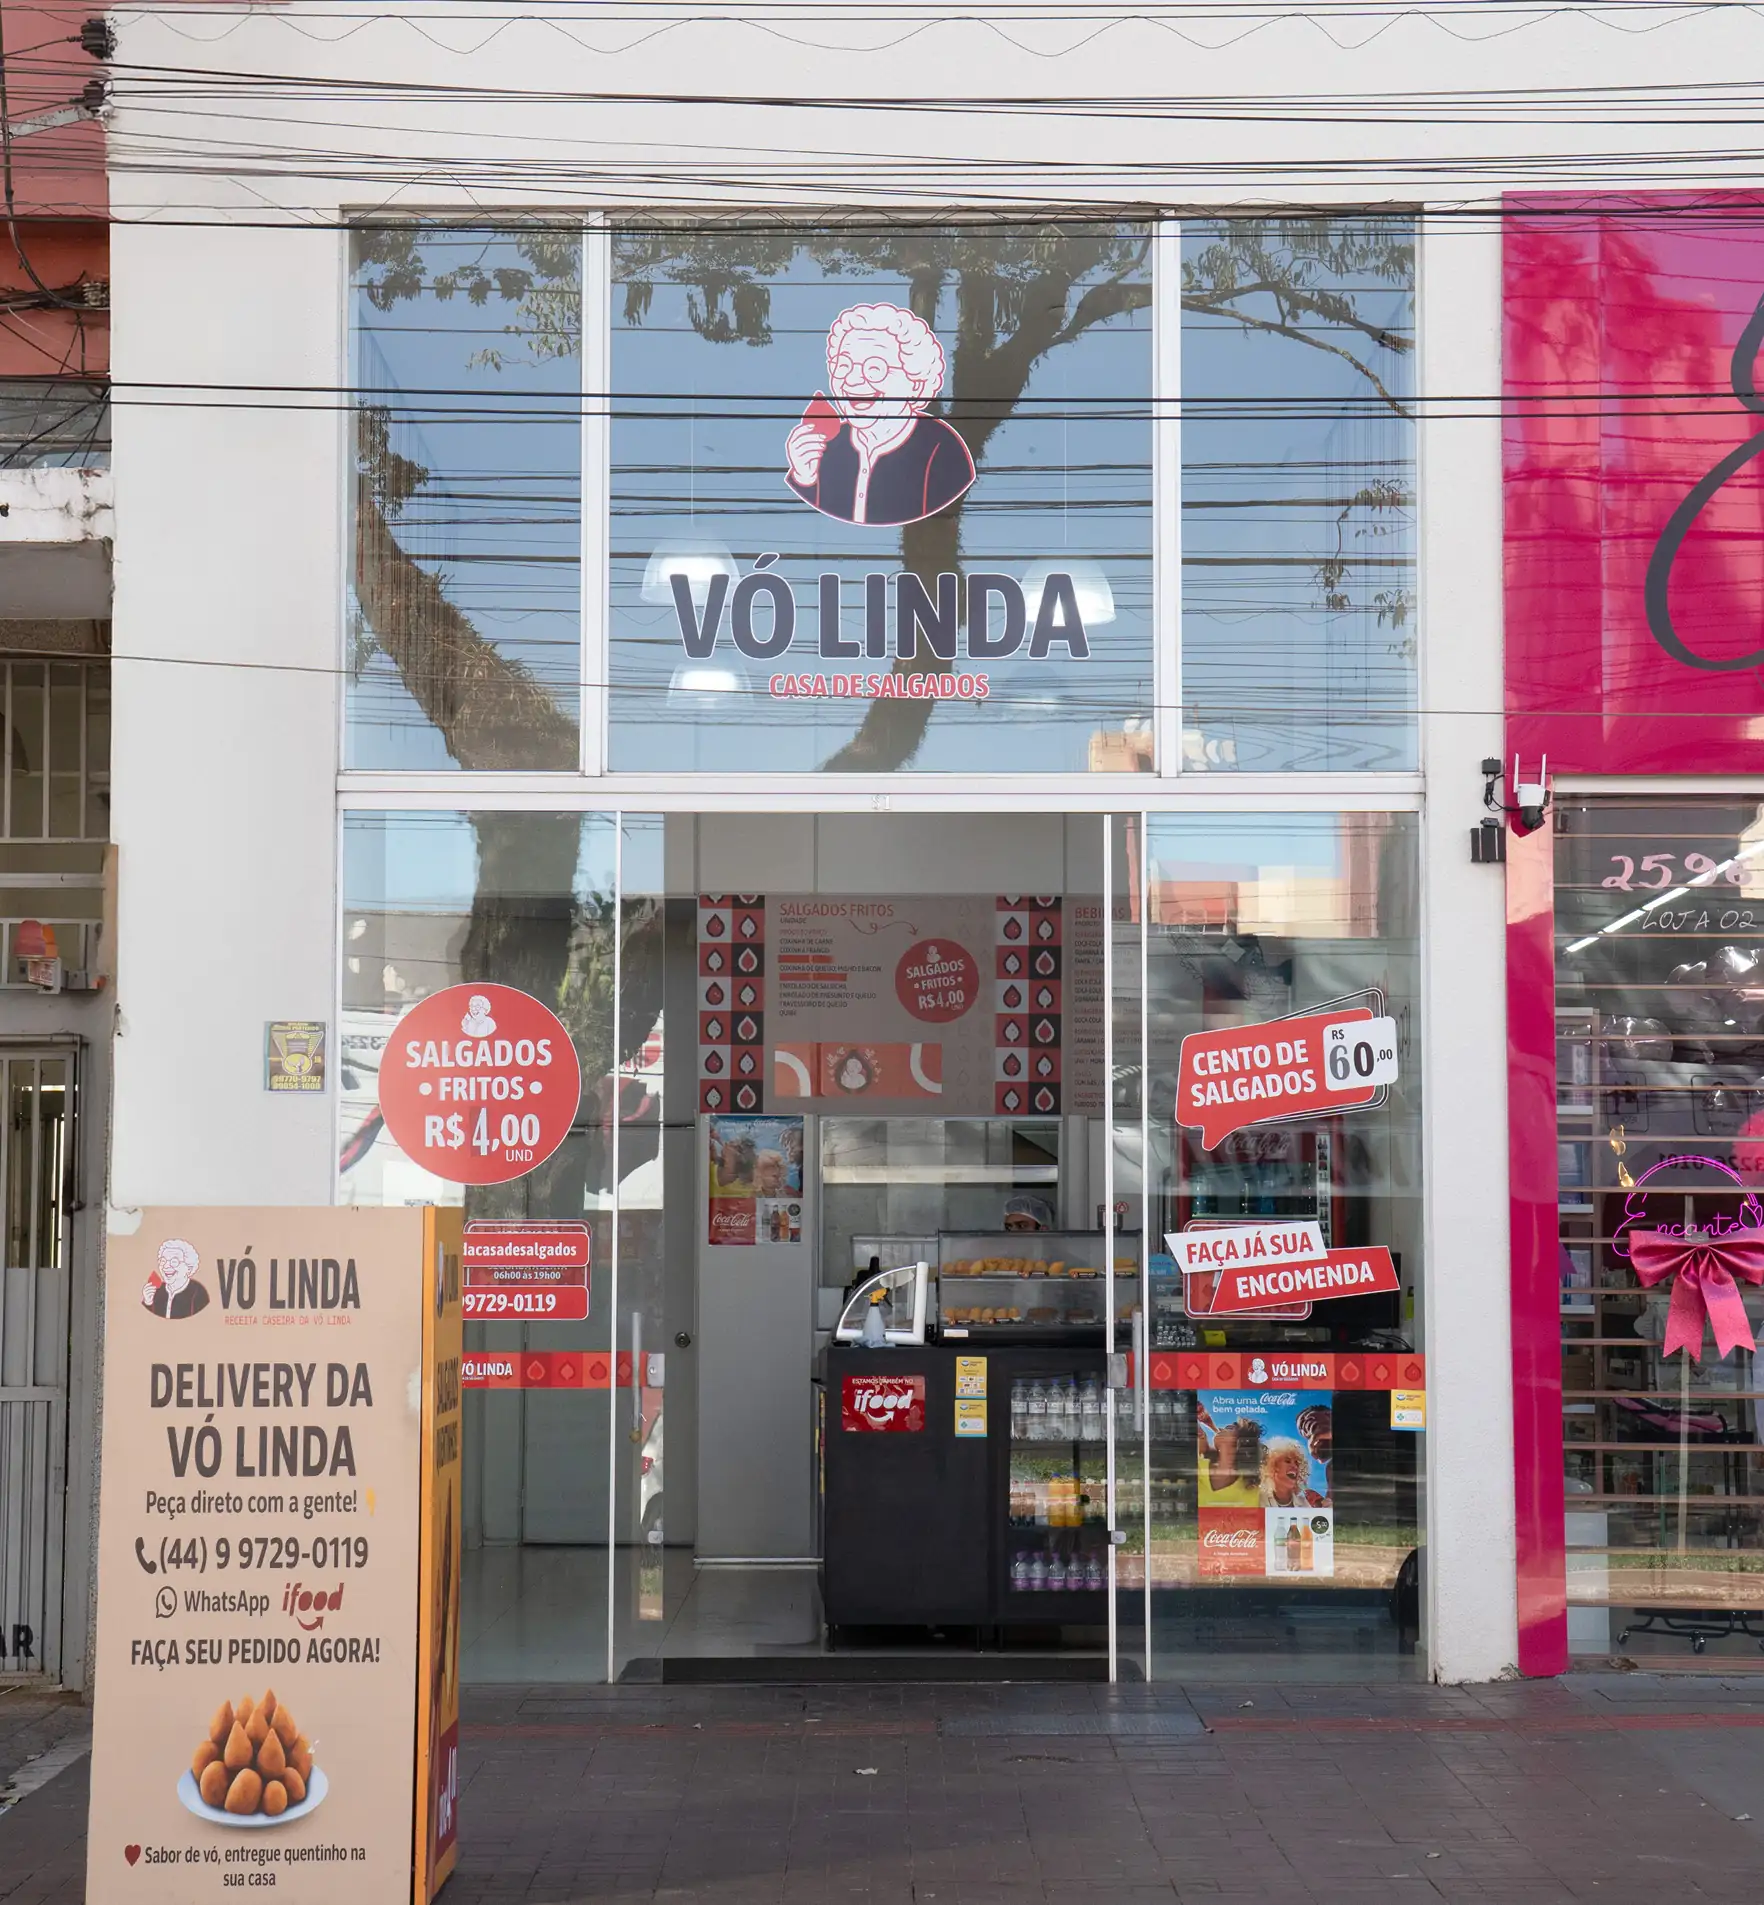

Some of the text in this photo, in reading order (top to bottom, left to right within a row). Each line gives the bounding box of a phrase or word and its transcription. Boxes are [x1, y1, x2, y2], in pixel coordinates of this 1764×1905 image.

[669, 551, 1091, 660] VÓ LINDA
[769, 672, 990, 700] CASA DE SALGADOS
[1601, 852, 1754, 891] 2596
[779, 903, 894, 917] SALGADOS FRITOS
[1075, 907, 1125, 919] BEBIAS
[1642, 908, 1757, 931] LOJA 02
[906, 959, 965, 979] SALGADOS
[921, 976, 956, 990] FRITOS
[918, 990, 965, 1010] R$ 4,00
[406, 1039, 552, 1069] SALGADOS
[1192, 1039, 1309, 1077] CENTO DE
[439, 1076, 524, 1101] FRITOS
[1191, 1068, 1317, 1108] SALGADOS
[424, 1107, 541, 1156] R$ 4,00
[505, 1149, 533, 1162] UND
[712, 1212, 751, 1227] Coca-Cola
[1185, 1230, 1314, 1267] FAÇA JÁ SUA
[216, 1245, 361, 1310] VÓ LINDA
[493, 1271, 521, 1280] 06h00
[534, 1271, 561, 1280] 19h00
[1236, 1260, 1375, 1299] ENCOMENDA
[463, 1293, 556, 1312] 9729-0119
[225, 1315, 258, 1325] RECEITA
[262, 1315, 296, 1325] CASEIRA
[300, 1315, 309, 1325] DA
[327, 1315, 351, 1325] LINDA
[476, 1362, 513, 1376] LINDA
[1271, 1360, 1327, 1377] VÓ LINDA
[150, 1362, 373, 1408] DELIVERY DA
[880, 1377, 903, 1385] TAMBÉM
[854, 1389, 913, 1412] ifood
[1212, 1392, 1297, 1406] Abra uma Coca-Cola
[1212, 1405, 1268, 1414] bem gelada.
[167, 1413, 357, 1478] VÓ LINDA
[146, 1489, 358, 1520] Peça direto com a gente!
[1203, 1529, 1260, 1549] Coca-Cola
[159, 1536, 369, 1574] (44) 9 9729-0119
[183, 1582, 345, 1617] WhatsApp ifood
[131, 1637, 380, 1671] FAÇA SEU PEDIDO AGORA!
[145, 1844, 366, 1867] Sabor de vó, entregue quentinho na
[223, 1872, 276, 1887] sua casa
